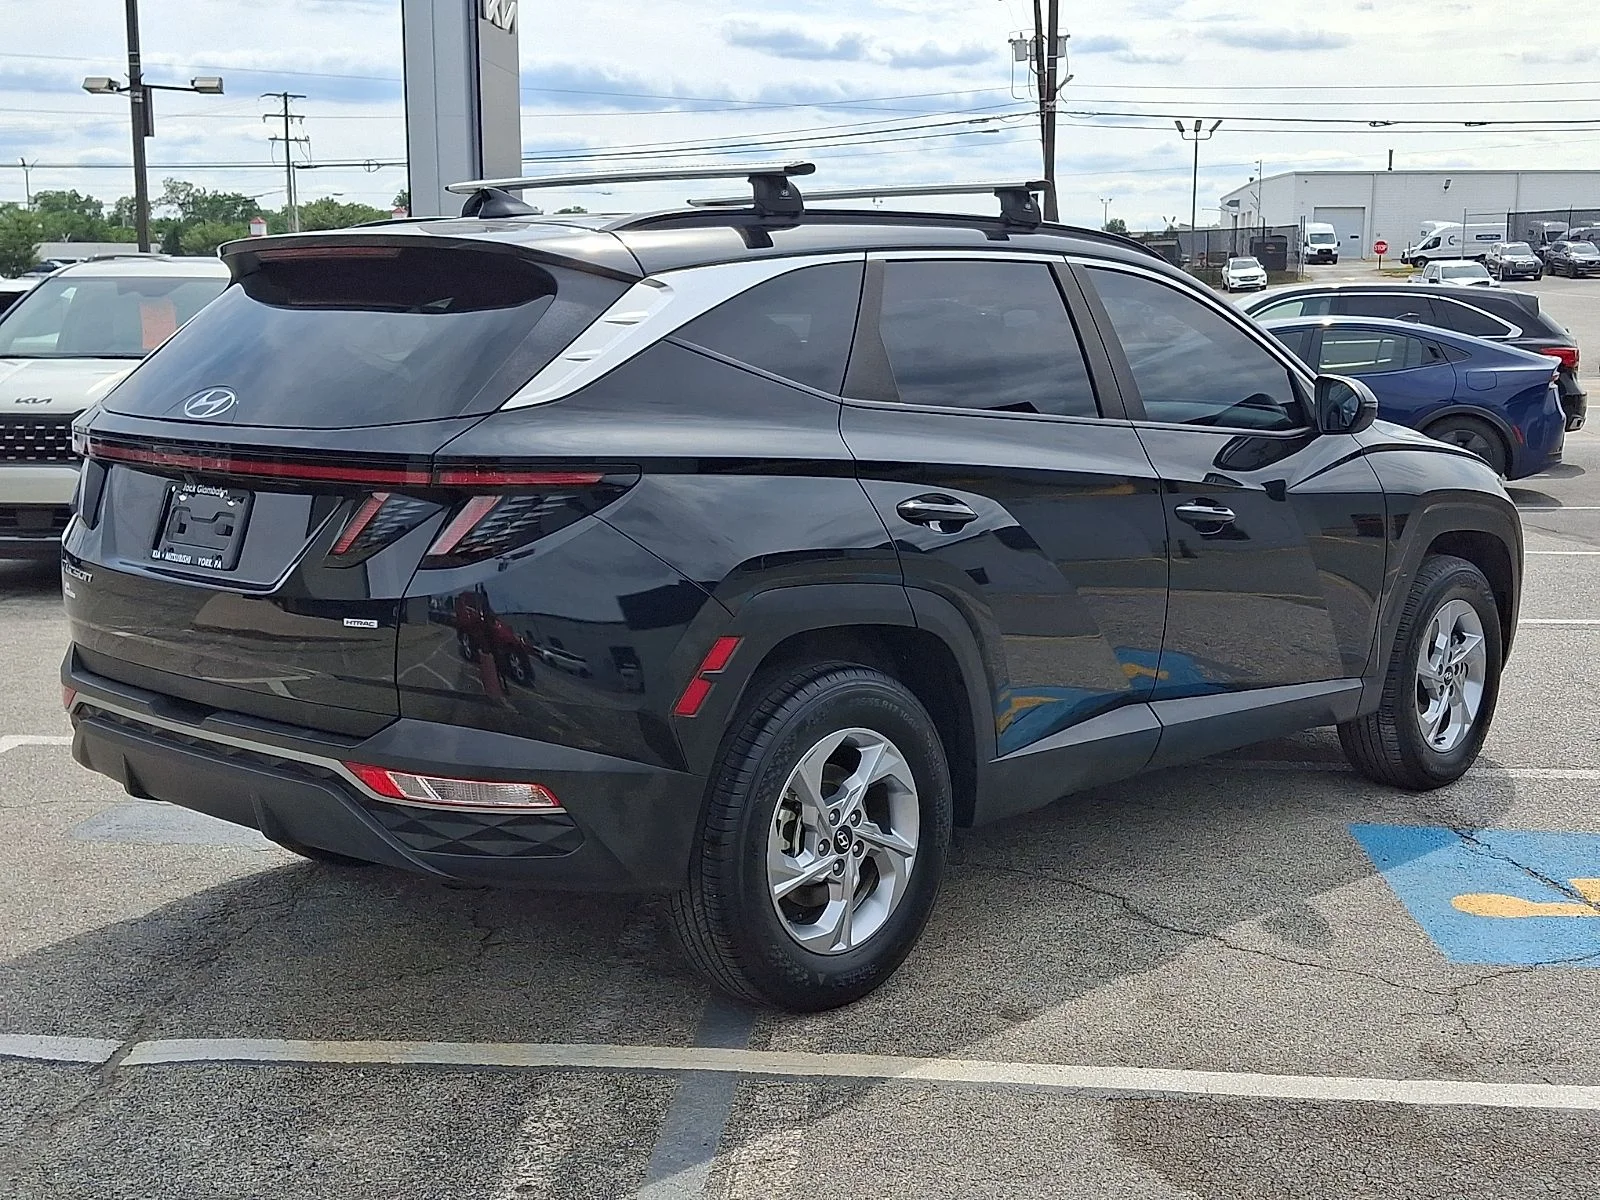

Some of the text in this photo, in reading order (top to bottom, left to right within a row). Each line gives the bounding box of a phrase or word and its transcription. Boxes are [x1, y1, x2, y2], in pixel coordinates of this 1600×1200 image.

[182, 483, 196, 493] Jack
[152, 550, 160, 559] KIA
[213, 559, 222, 569] PA
[345, 619, 376, 627] HTRAC
